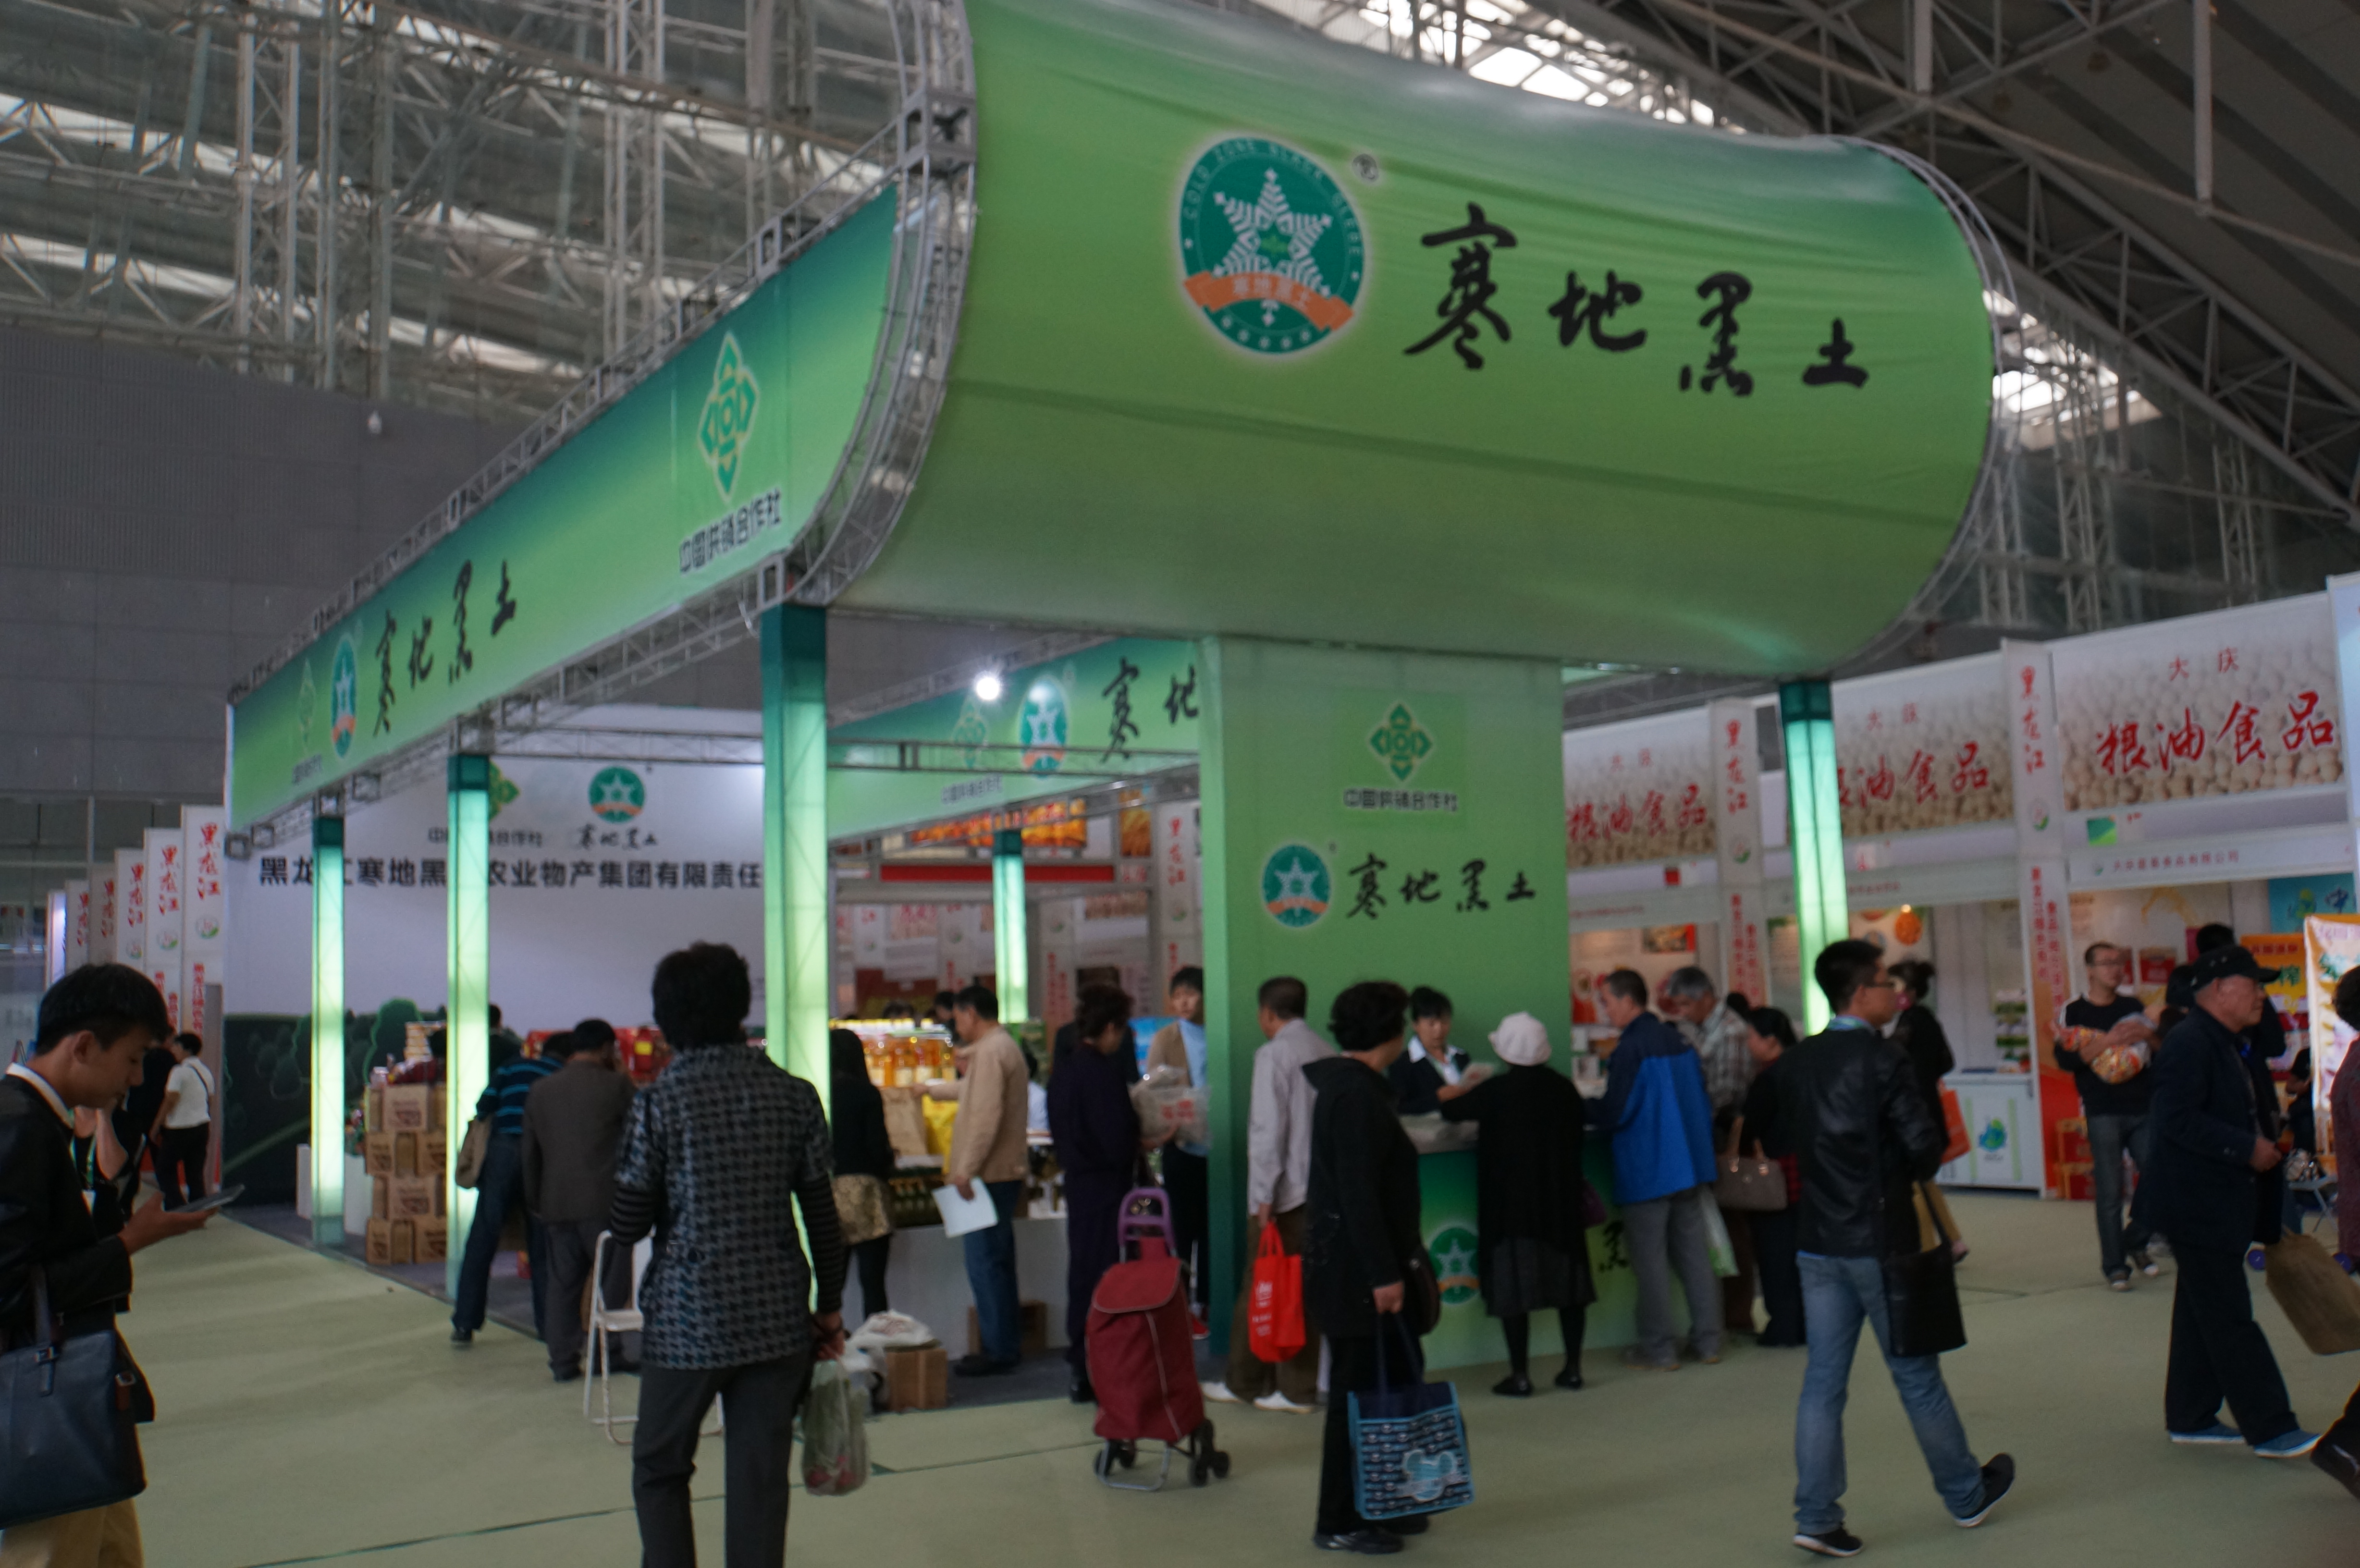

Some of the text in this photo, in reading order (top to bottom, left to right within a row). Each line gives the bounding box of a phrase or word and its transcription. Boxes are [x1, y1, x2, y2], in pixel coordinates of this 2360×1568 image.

[1402, 202, 1868, 397] 寒地黑土
[372, 559, 517, 738] 寒地黑土
[2096, 689, 2335, 776] 粮油食品
[1346, 852, 1536, 920] 寒地黑土
